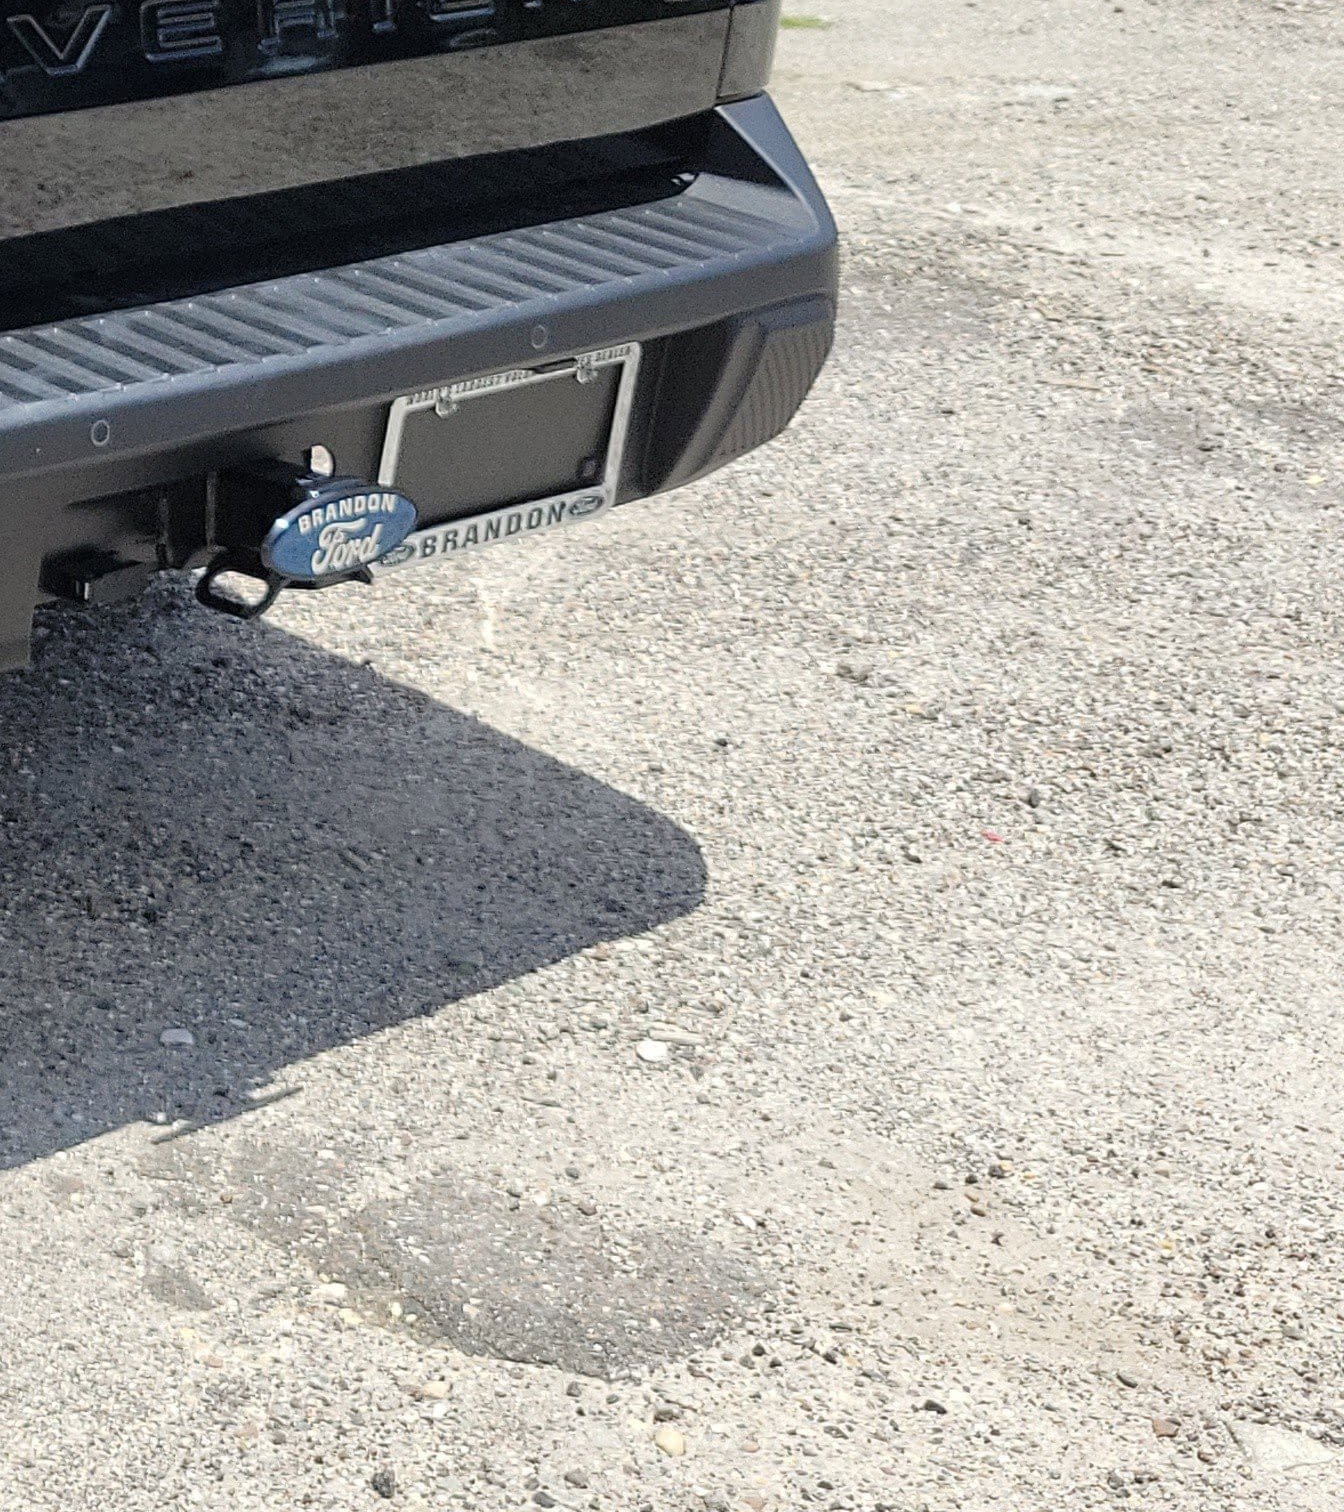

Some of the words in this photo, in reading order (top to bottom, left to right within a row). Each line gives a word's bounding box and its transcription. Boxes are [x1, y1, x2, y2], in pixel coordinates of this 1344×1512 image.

[298, 492, 397, 534] BRANDON
[420, 501, 566, 559] BRANDON
[311, 518, 383, 576] Ford
